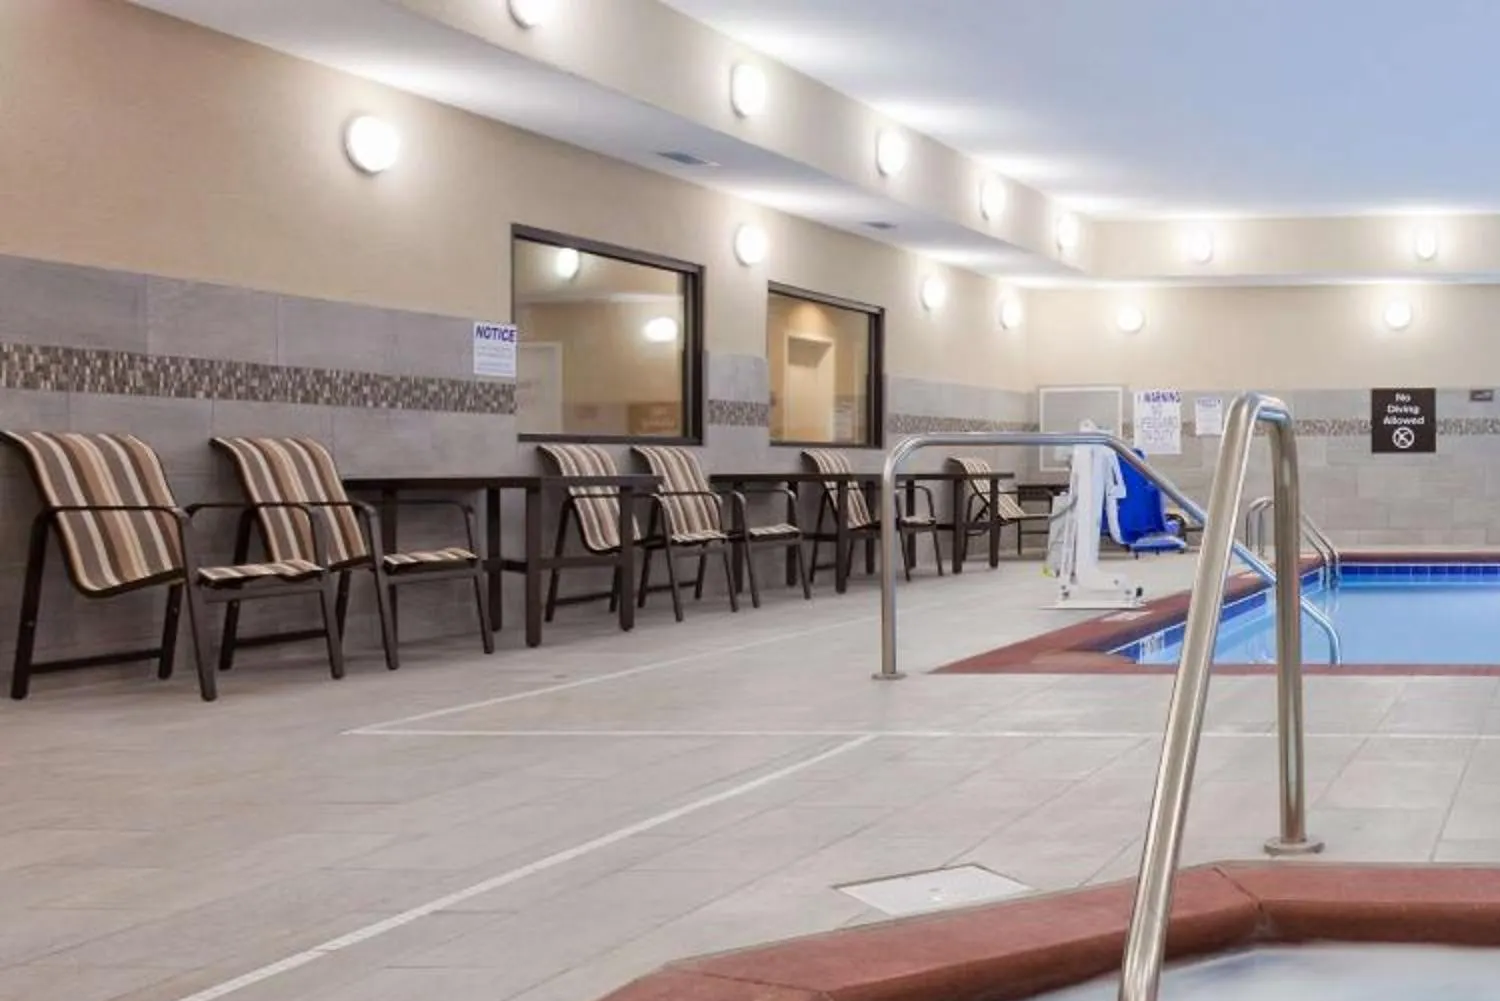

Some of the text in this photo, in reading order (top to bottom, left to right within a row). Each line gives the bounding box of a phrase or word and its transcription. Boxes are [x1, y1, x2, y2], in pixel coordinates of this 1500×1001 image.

[476, 325, 516, 343] NOTICE
[1395, 393, 1411, 402] No
[1387, 404, 1420, 415] Diving
[1383, 416, 1425, 425] Allowed
